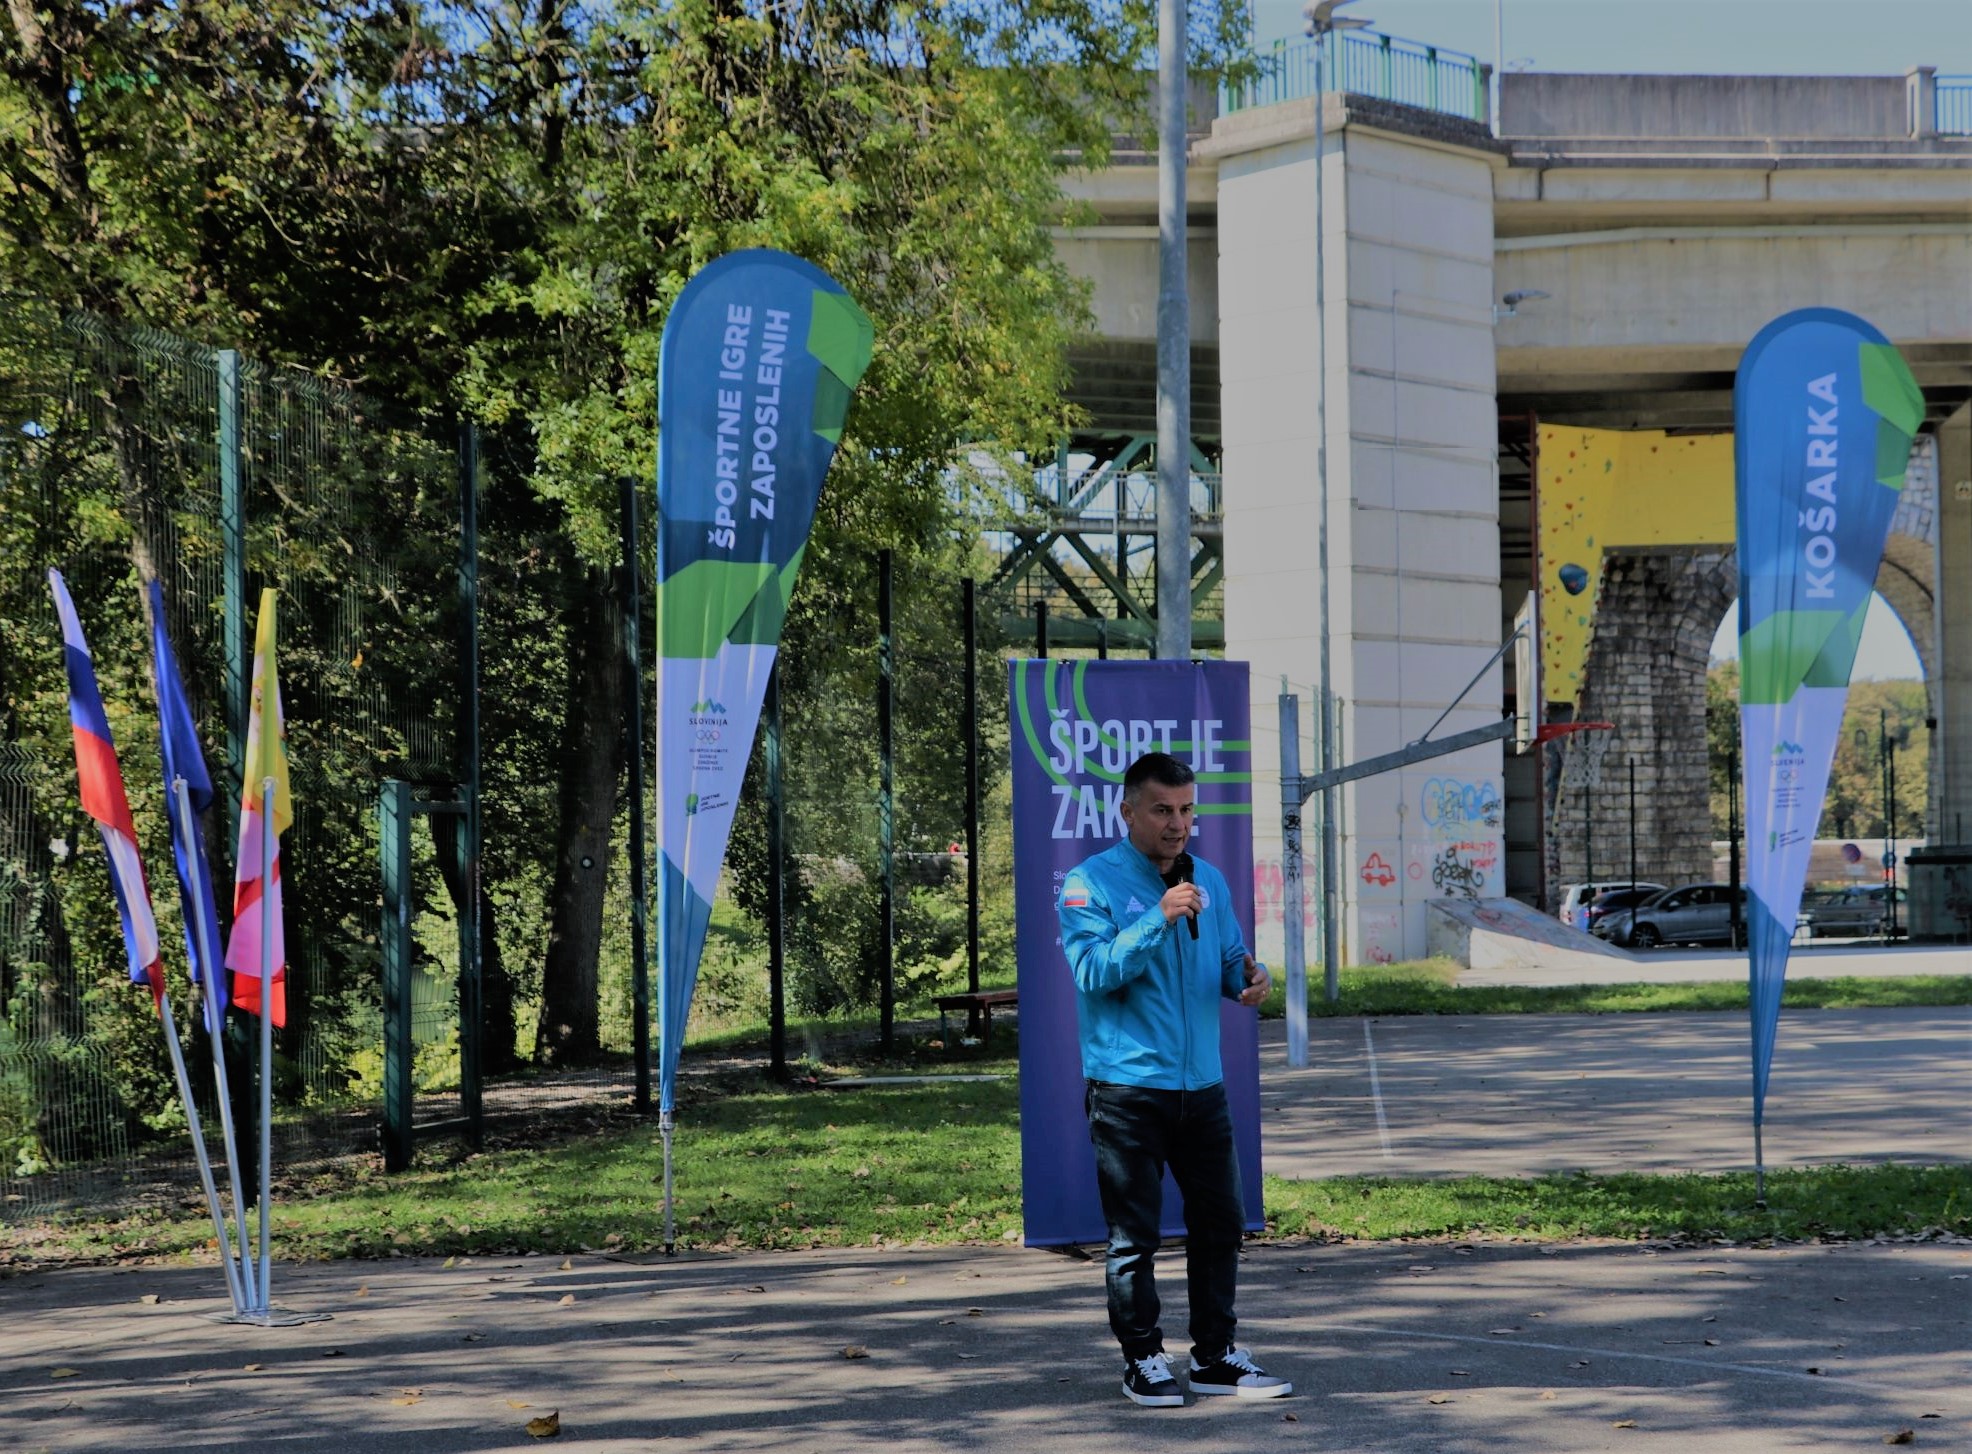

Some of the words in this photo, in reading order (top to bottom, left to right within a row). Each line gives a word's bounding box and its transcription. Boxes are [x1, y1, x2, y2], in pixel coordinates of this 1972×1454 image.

[719, 303, 752, 380] IGRE
[708, 388, 742, 550] ŠPORTNE
[750, 309, 790, 520] ZAPOSLENIH
[1798, 372, 1838, 599] KOŠARKA
[1049, 709, 1178, 774] ŠPORT
[1190, 720, 1225, 773] JE
[1051, 784, 1200, 839] ZAK!
